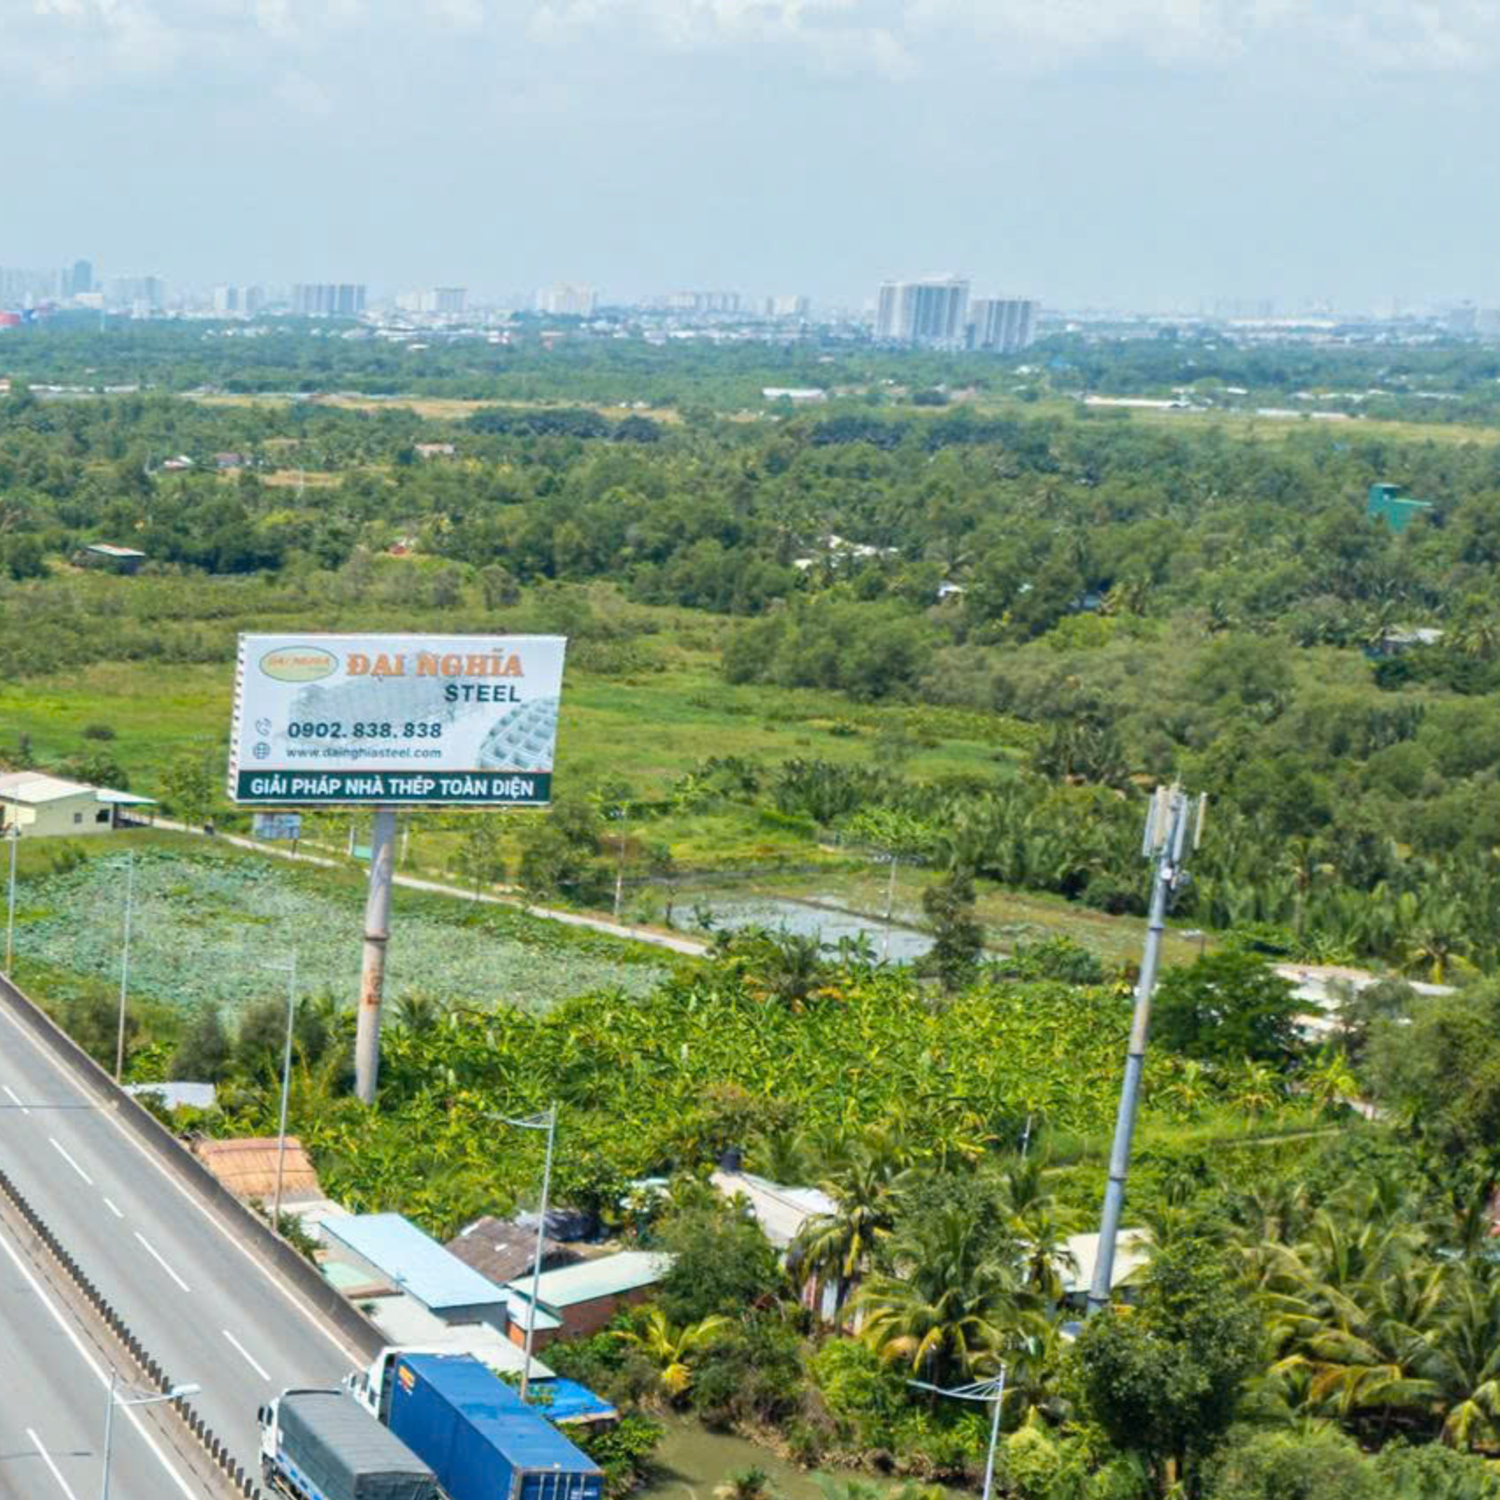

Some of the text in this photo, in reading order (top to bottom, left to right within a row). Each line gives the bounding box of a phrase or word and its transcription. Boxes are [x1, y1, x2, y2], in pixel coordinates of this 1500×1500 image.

[346, 648, 525, 682] ĐẠI NGHĨA
[444, 684, 522, 702] STEEL
[403, 722, 442, 738] 838
[286, 747, 442, 760] www.dainghiasteel.com
[250, 773, 534, 799] GIẢI PHÁP NHÀ THÉP TOÀN DIỆN
